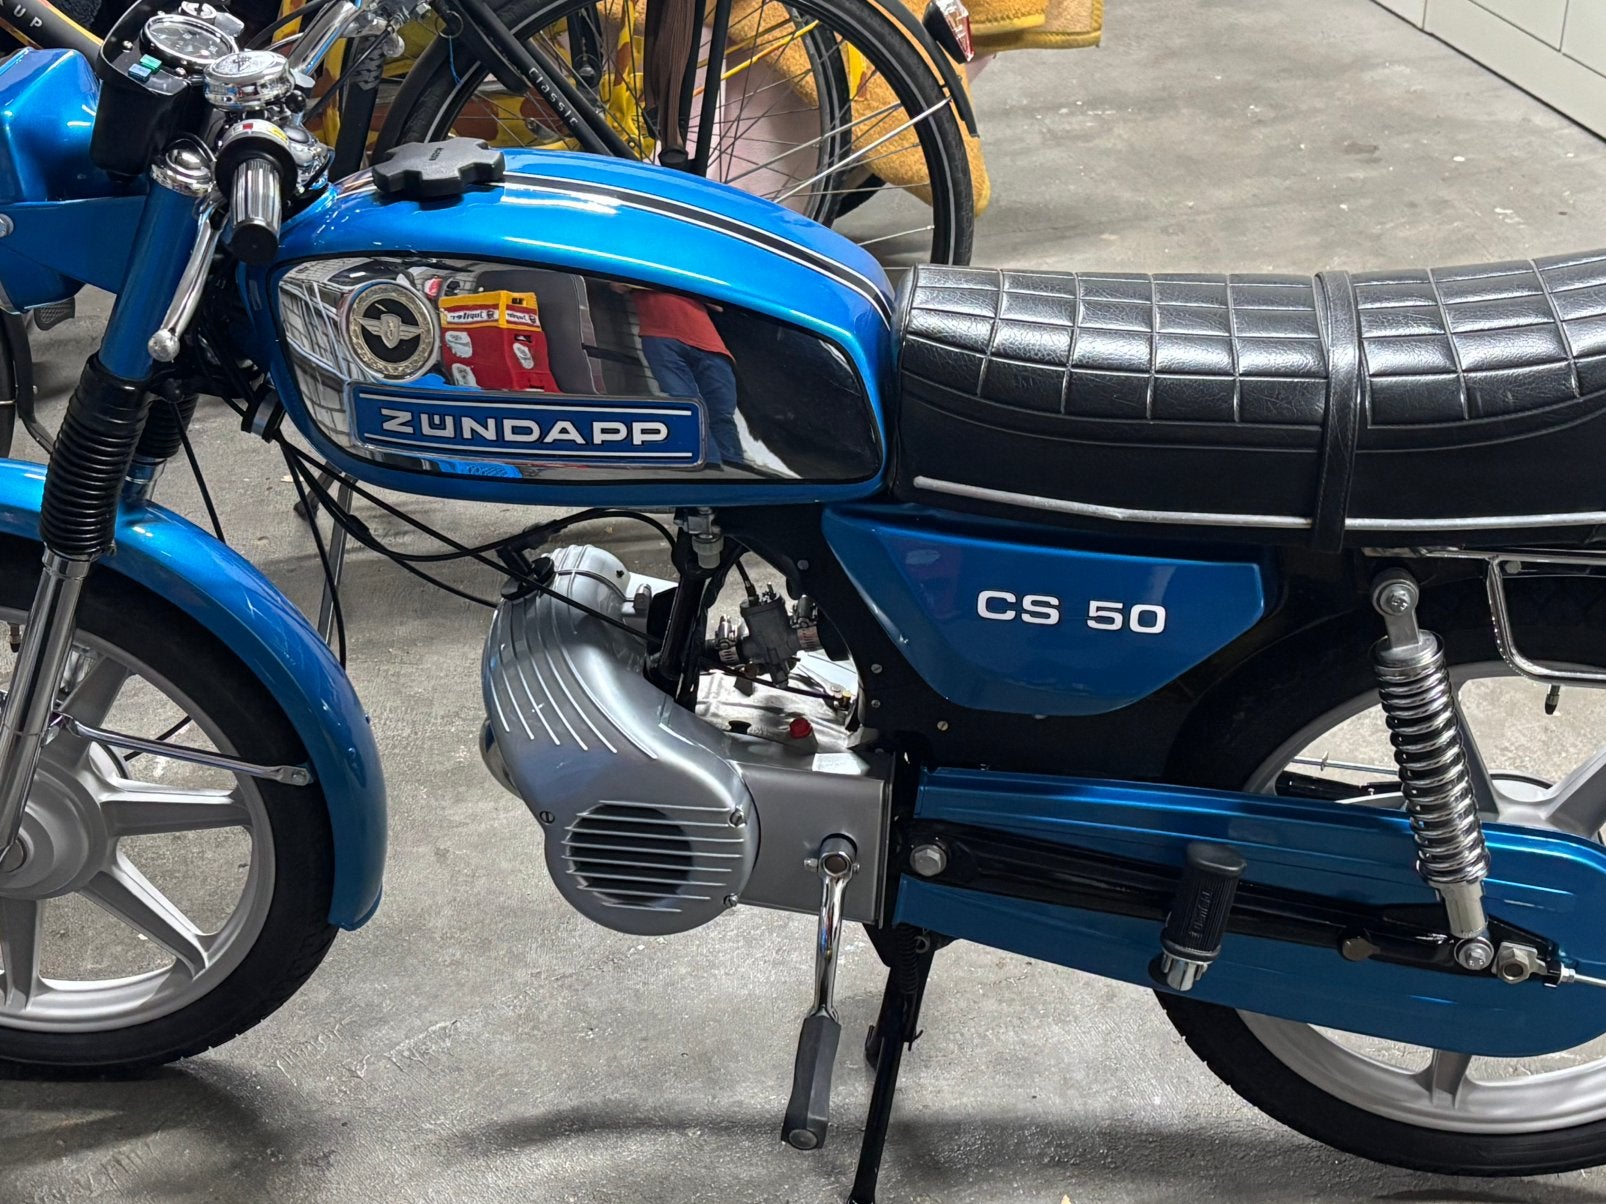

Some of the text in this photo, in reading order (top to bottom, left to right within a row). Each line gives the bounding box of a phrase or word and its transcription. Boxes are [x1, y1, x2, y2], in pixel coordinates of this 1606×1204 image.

[529, 67, 579, 126] Classic
[380, 408, 668, 444] ZÜNDAPP
[976, 590, 1167, 634] CS 50
